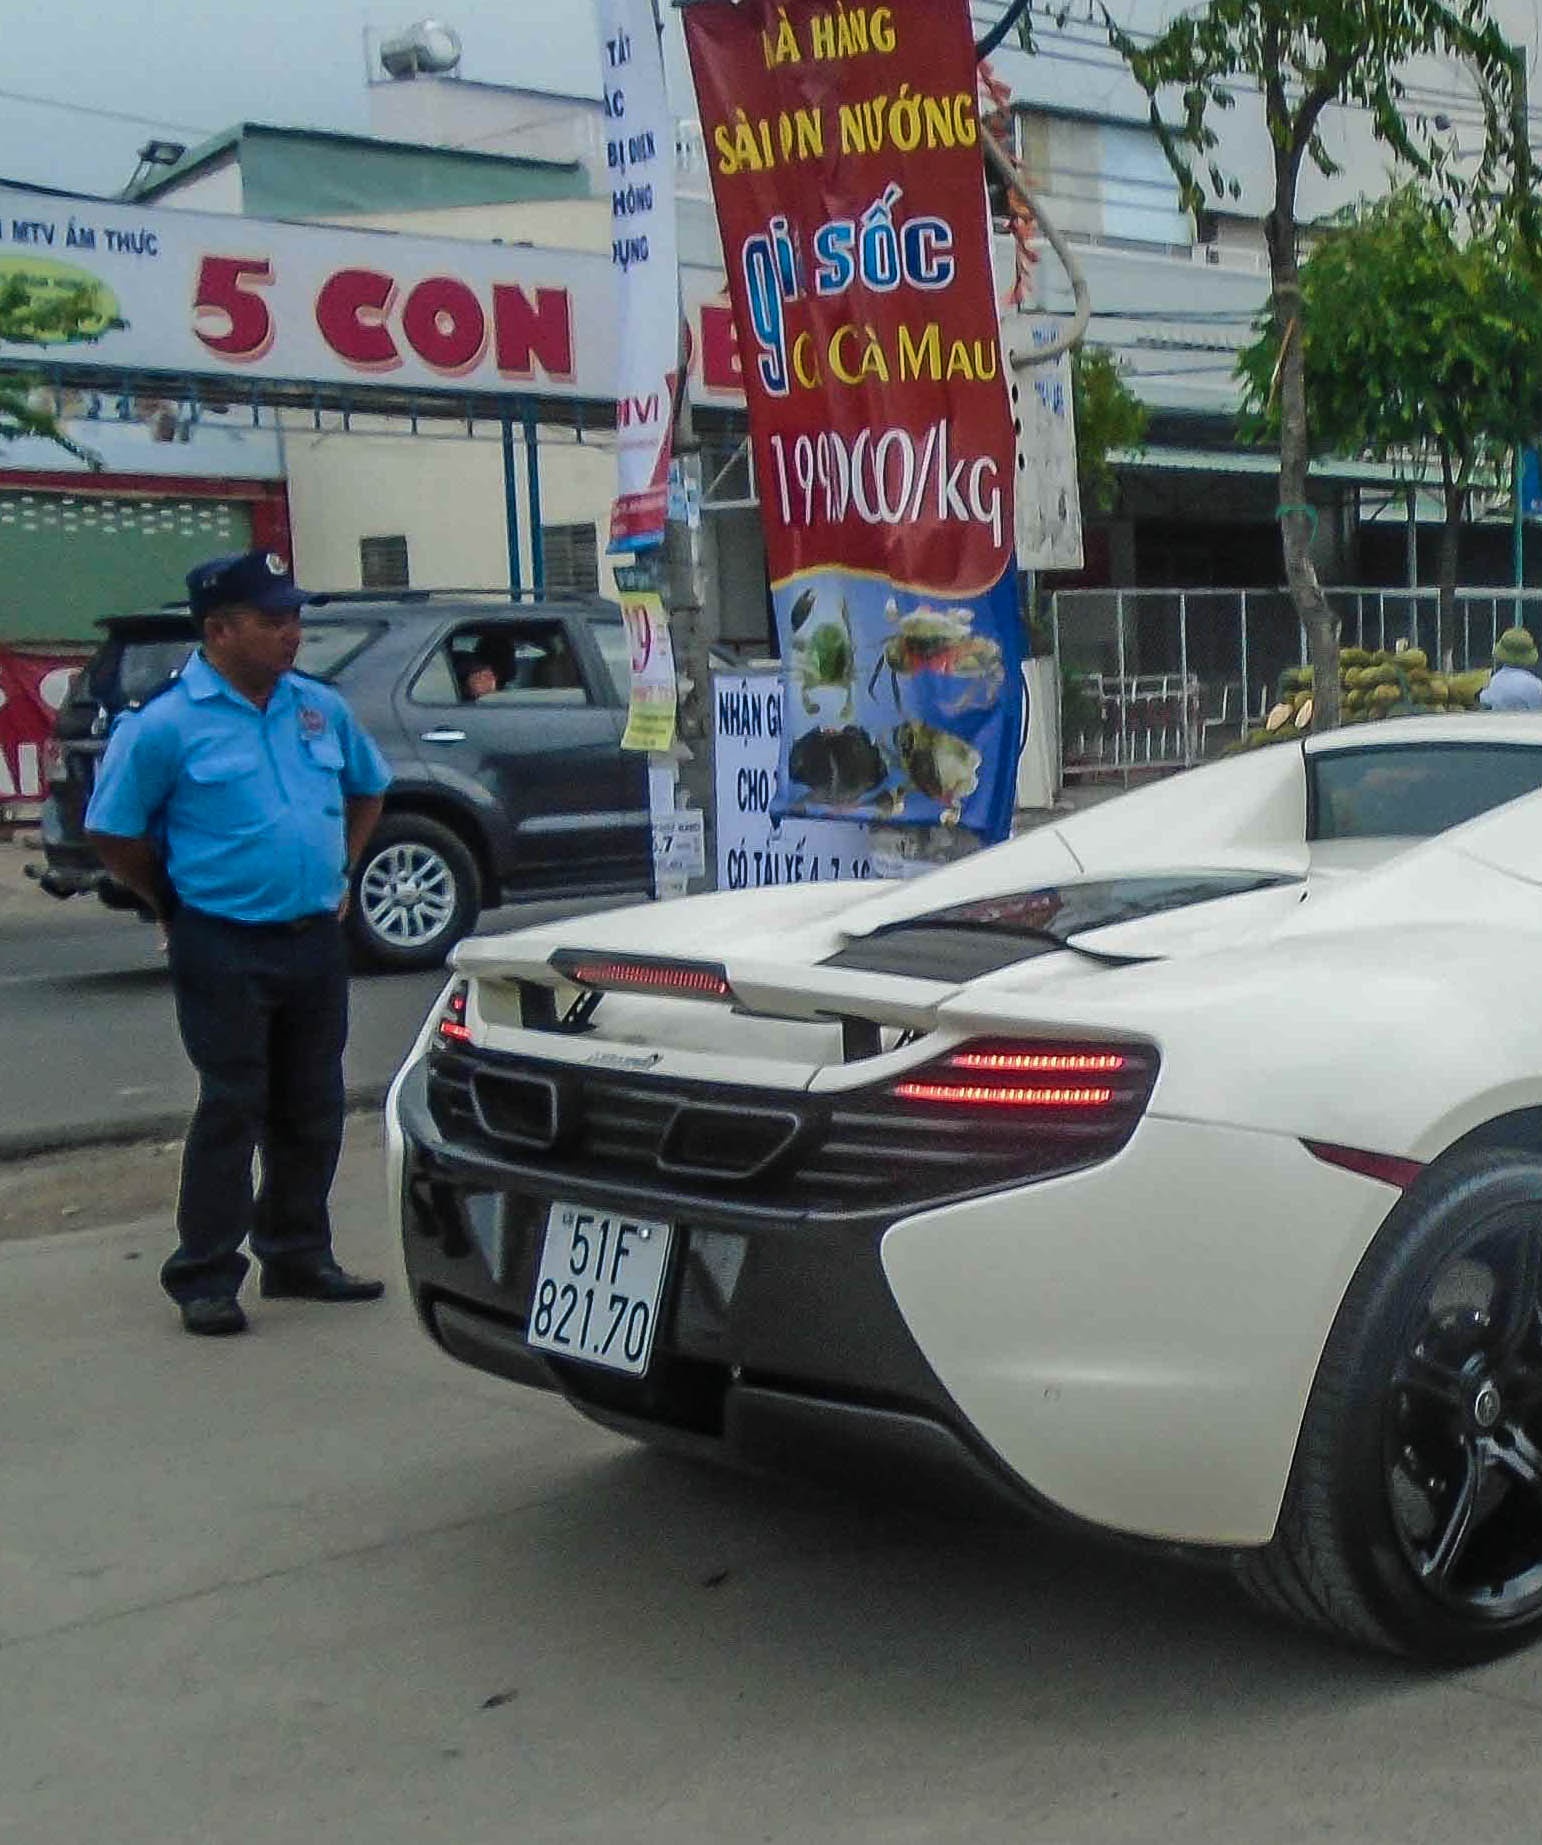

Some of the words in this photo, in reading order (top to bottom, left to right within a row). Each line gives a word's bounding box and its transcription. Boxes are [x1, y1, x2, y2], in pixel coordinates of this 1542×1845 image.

[810, 0, 898, 60] HÀNG
[838, 83, 977, 155] NƯỚNG
[196, 255, 277, 364] 5
[315, 269, 578, 383] CON
[737, 767, 769, 812] CHO
[727, 838, 749, 890] CÓ
[569, 1212, 639, 1285] 51F
[534, 1277, 651, 1363] 821.70
